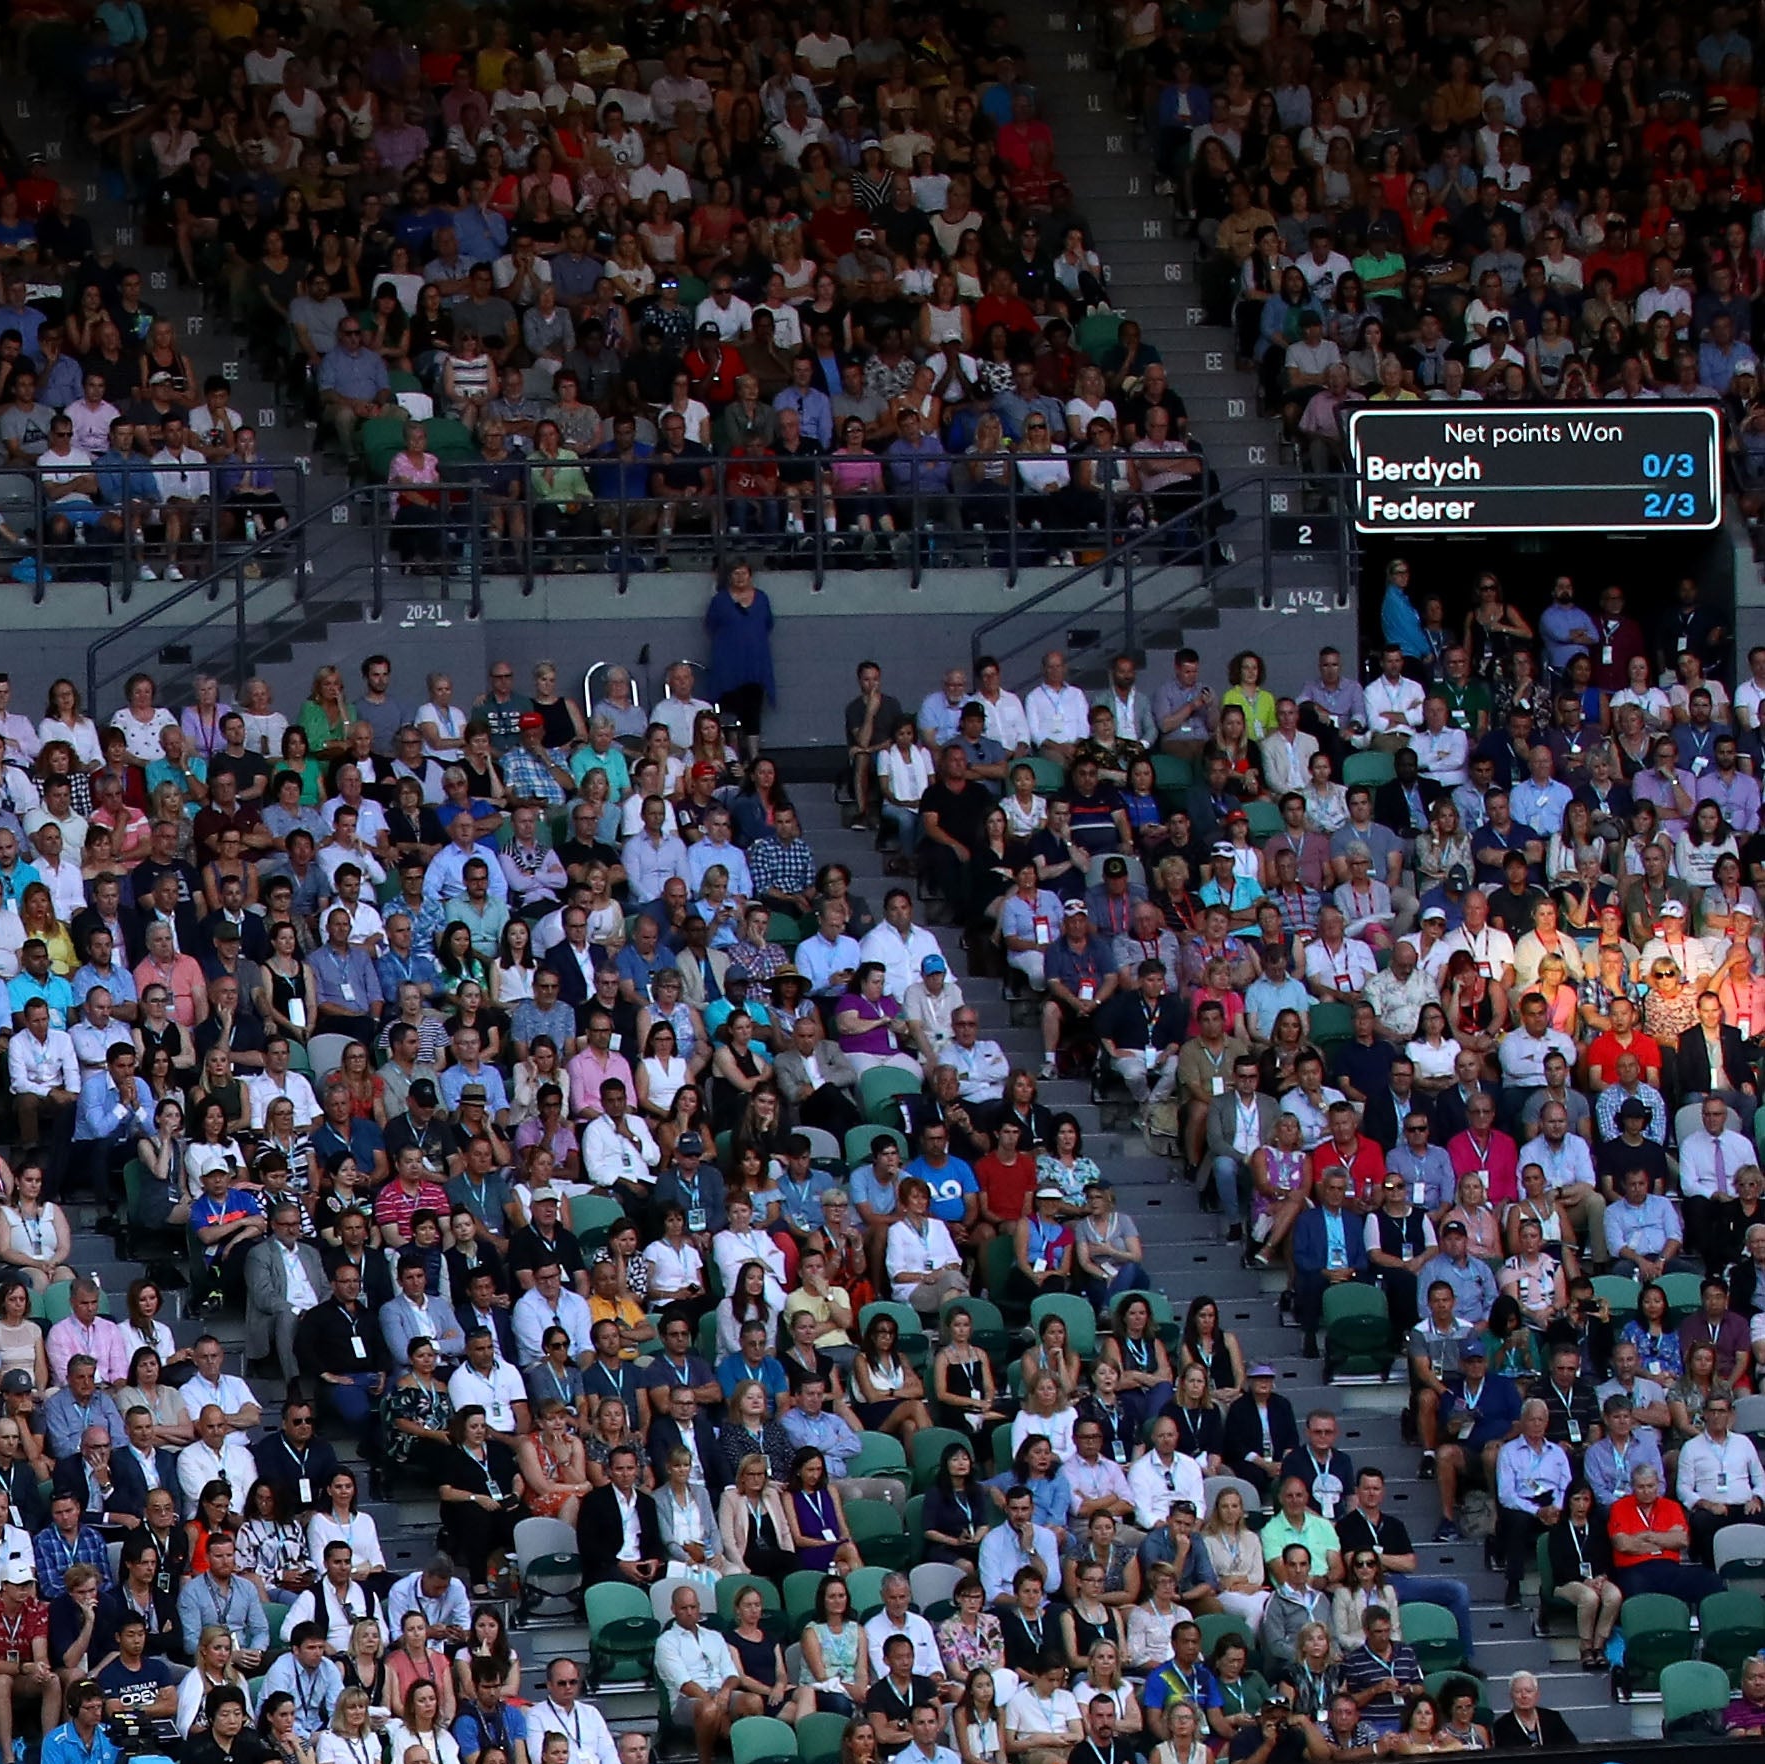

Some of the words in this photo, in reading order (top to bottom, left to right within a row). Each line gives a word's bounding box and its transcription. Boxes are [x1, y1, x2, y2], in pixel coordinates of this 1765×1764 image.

[16, 100, 31, 118] LL
[1087, 94, 1102, 112] LL
[1128, 176, 1140, 195] JJ
[116, 227, 134, 245] HH
[1143, 221, 1161, 239] HH
[1164, 264, 1181, 281] GG
[186, 316, 204, 335] FF
[1206, 352, 1222, 370] EE
[222, 362, 239, 380] EE
[1228, 399, 1245, 417] DD
[258, 409, 275, 427] DD
[1445, 424, 1485, 443] Net
[1492, 423, 1560, 447] points
[1569, 422, 1622, 442] Won
[1248, 446, 1266, 464] CC
[1367, 455, 1480, 486] Berdych
[1642, 454, 1694, 477] 0/3
[1270, 494, 1288, 513] BB
[1368, 496, 1475, 520] Federer
[1644, 494, 1695, 518] 2/3
[331, 505, 348, 523] BB
[1298, 525, 1312, 544] 2
[1288, 592, 1323, 606] 41-42
[407, 604, 442, 620] 20-21
